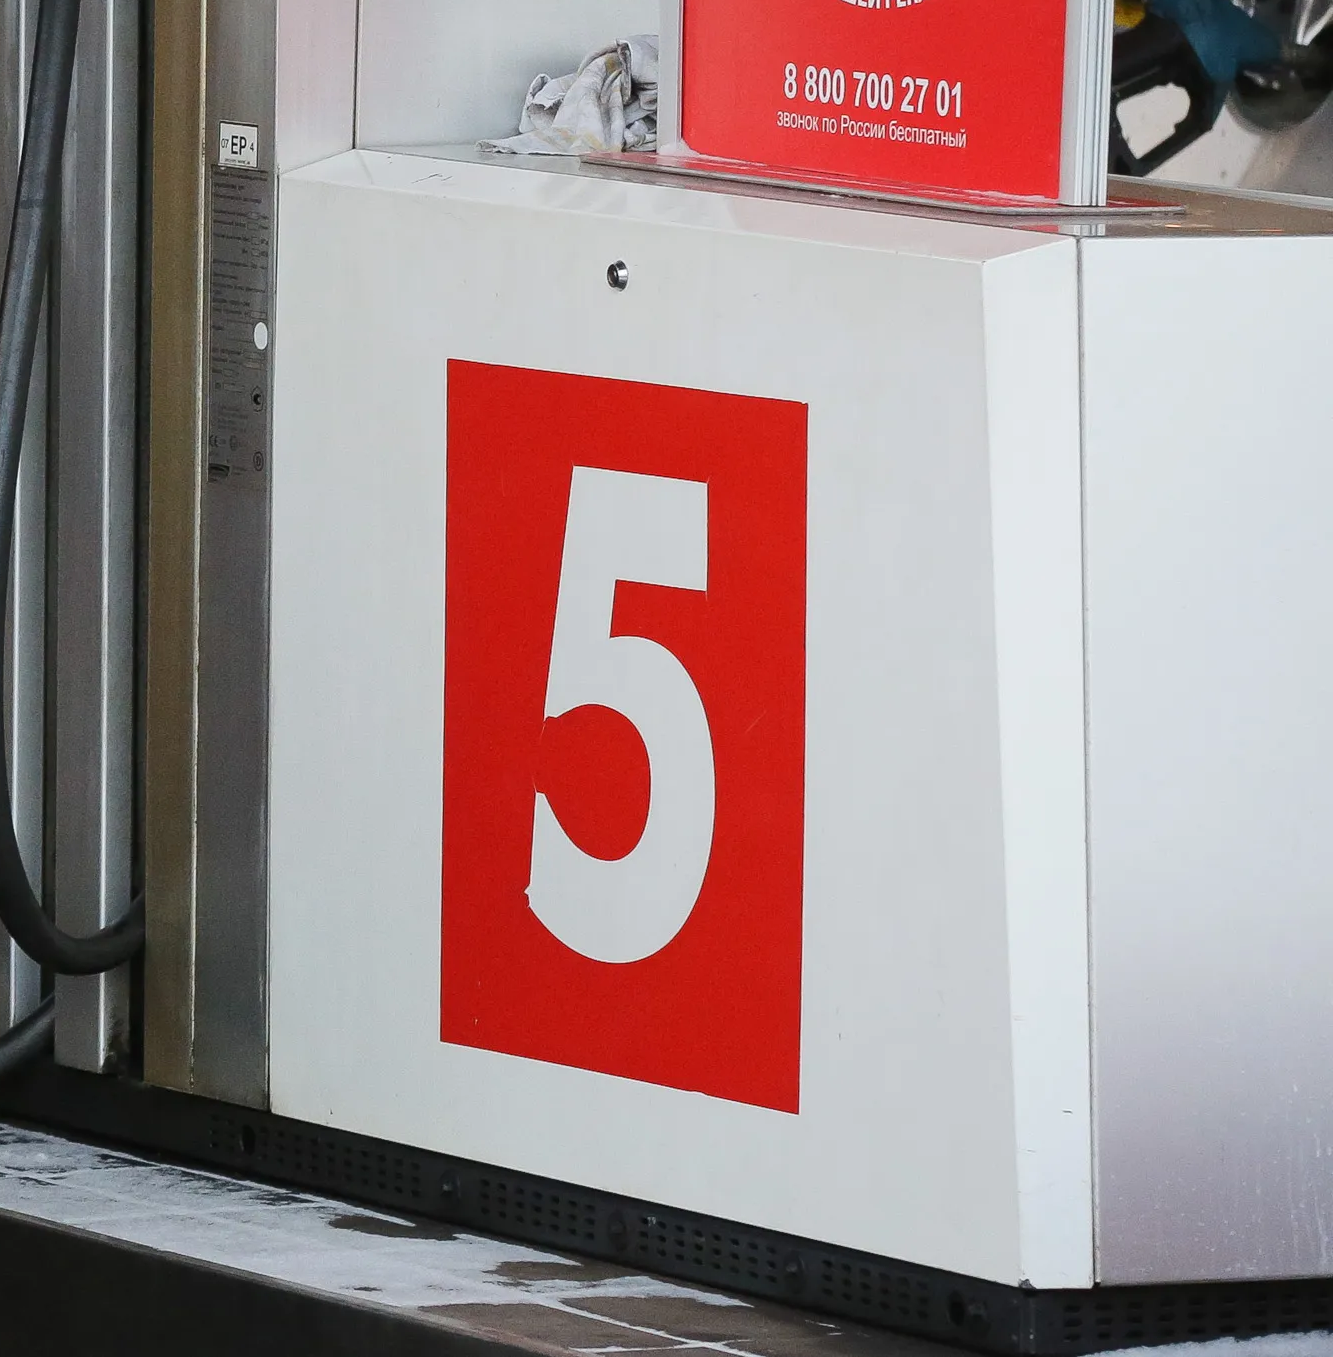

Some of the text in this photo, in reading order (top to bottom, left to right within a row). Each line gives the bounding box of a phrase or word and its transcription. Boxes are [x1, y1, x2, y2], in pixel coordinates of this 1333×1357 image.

[784, 61, 963, 118] 8 800 700 27 01
[231, 135, 247, 155] EP
[777, 111, 967, 148] звонок по России бесплатный
[524, 465, 716, 964] 5
